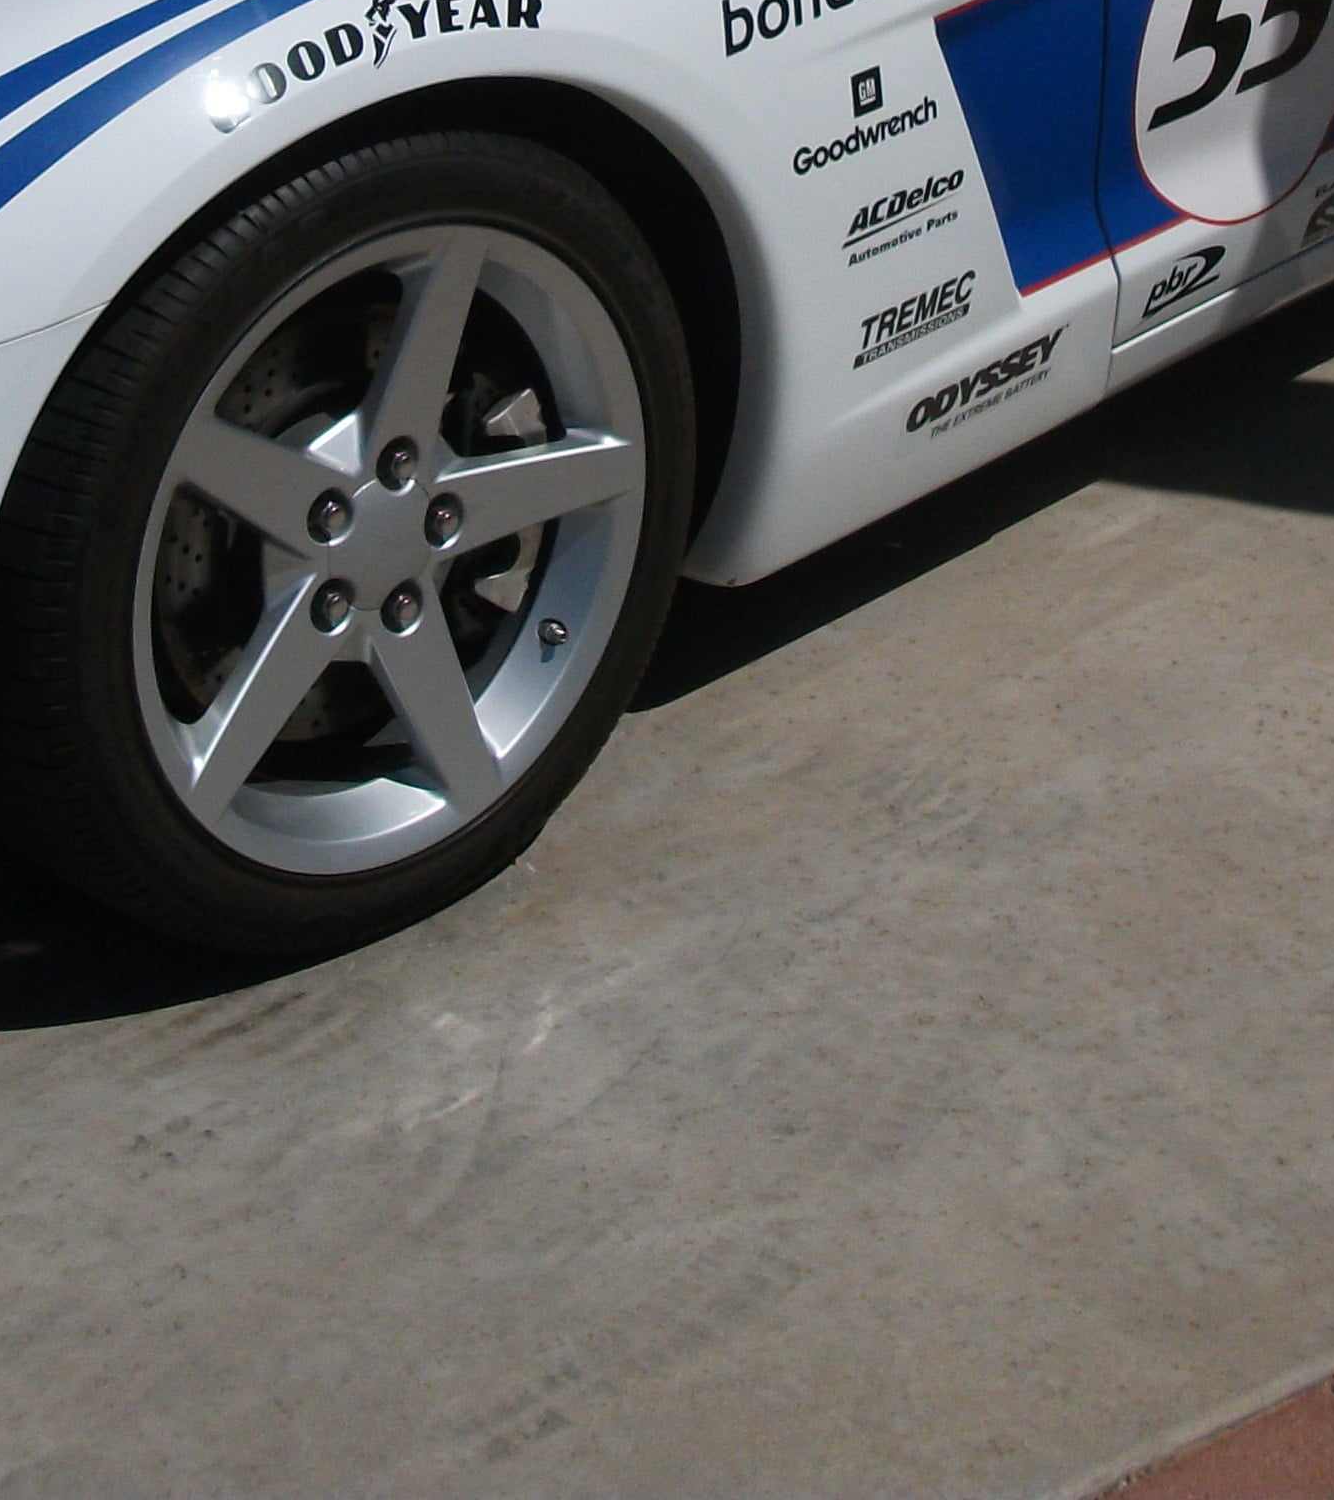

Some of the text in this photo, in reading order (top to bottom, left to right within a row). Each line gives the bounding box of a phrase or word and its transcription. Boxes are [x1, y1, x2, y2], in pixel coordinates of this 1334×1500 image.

[793, 96, 938, 175] Goodwrench
[847, 169, 964, 238] ACDelco
[848, 210, 958, 267] Automotive Parts
[861, 269, 976, 350] TREMEC
[863, 306, 964, 365] TRANSMISSIONS
[906, 327, 1064, 432] ODYSSEY
[930, 368, 1051, 439] THE EXTREME BATTERY
